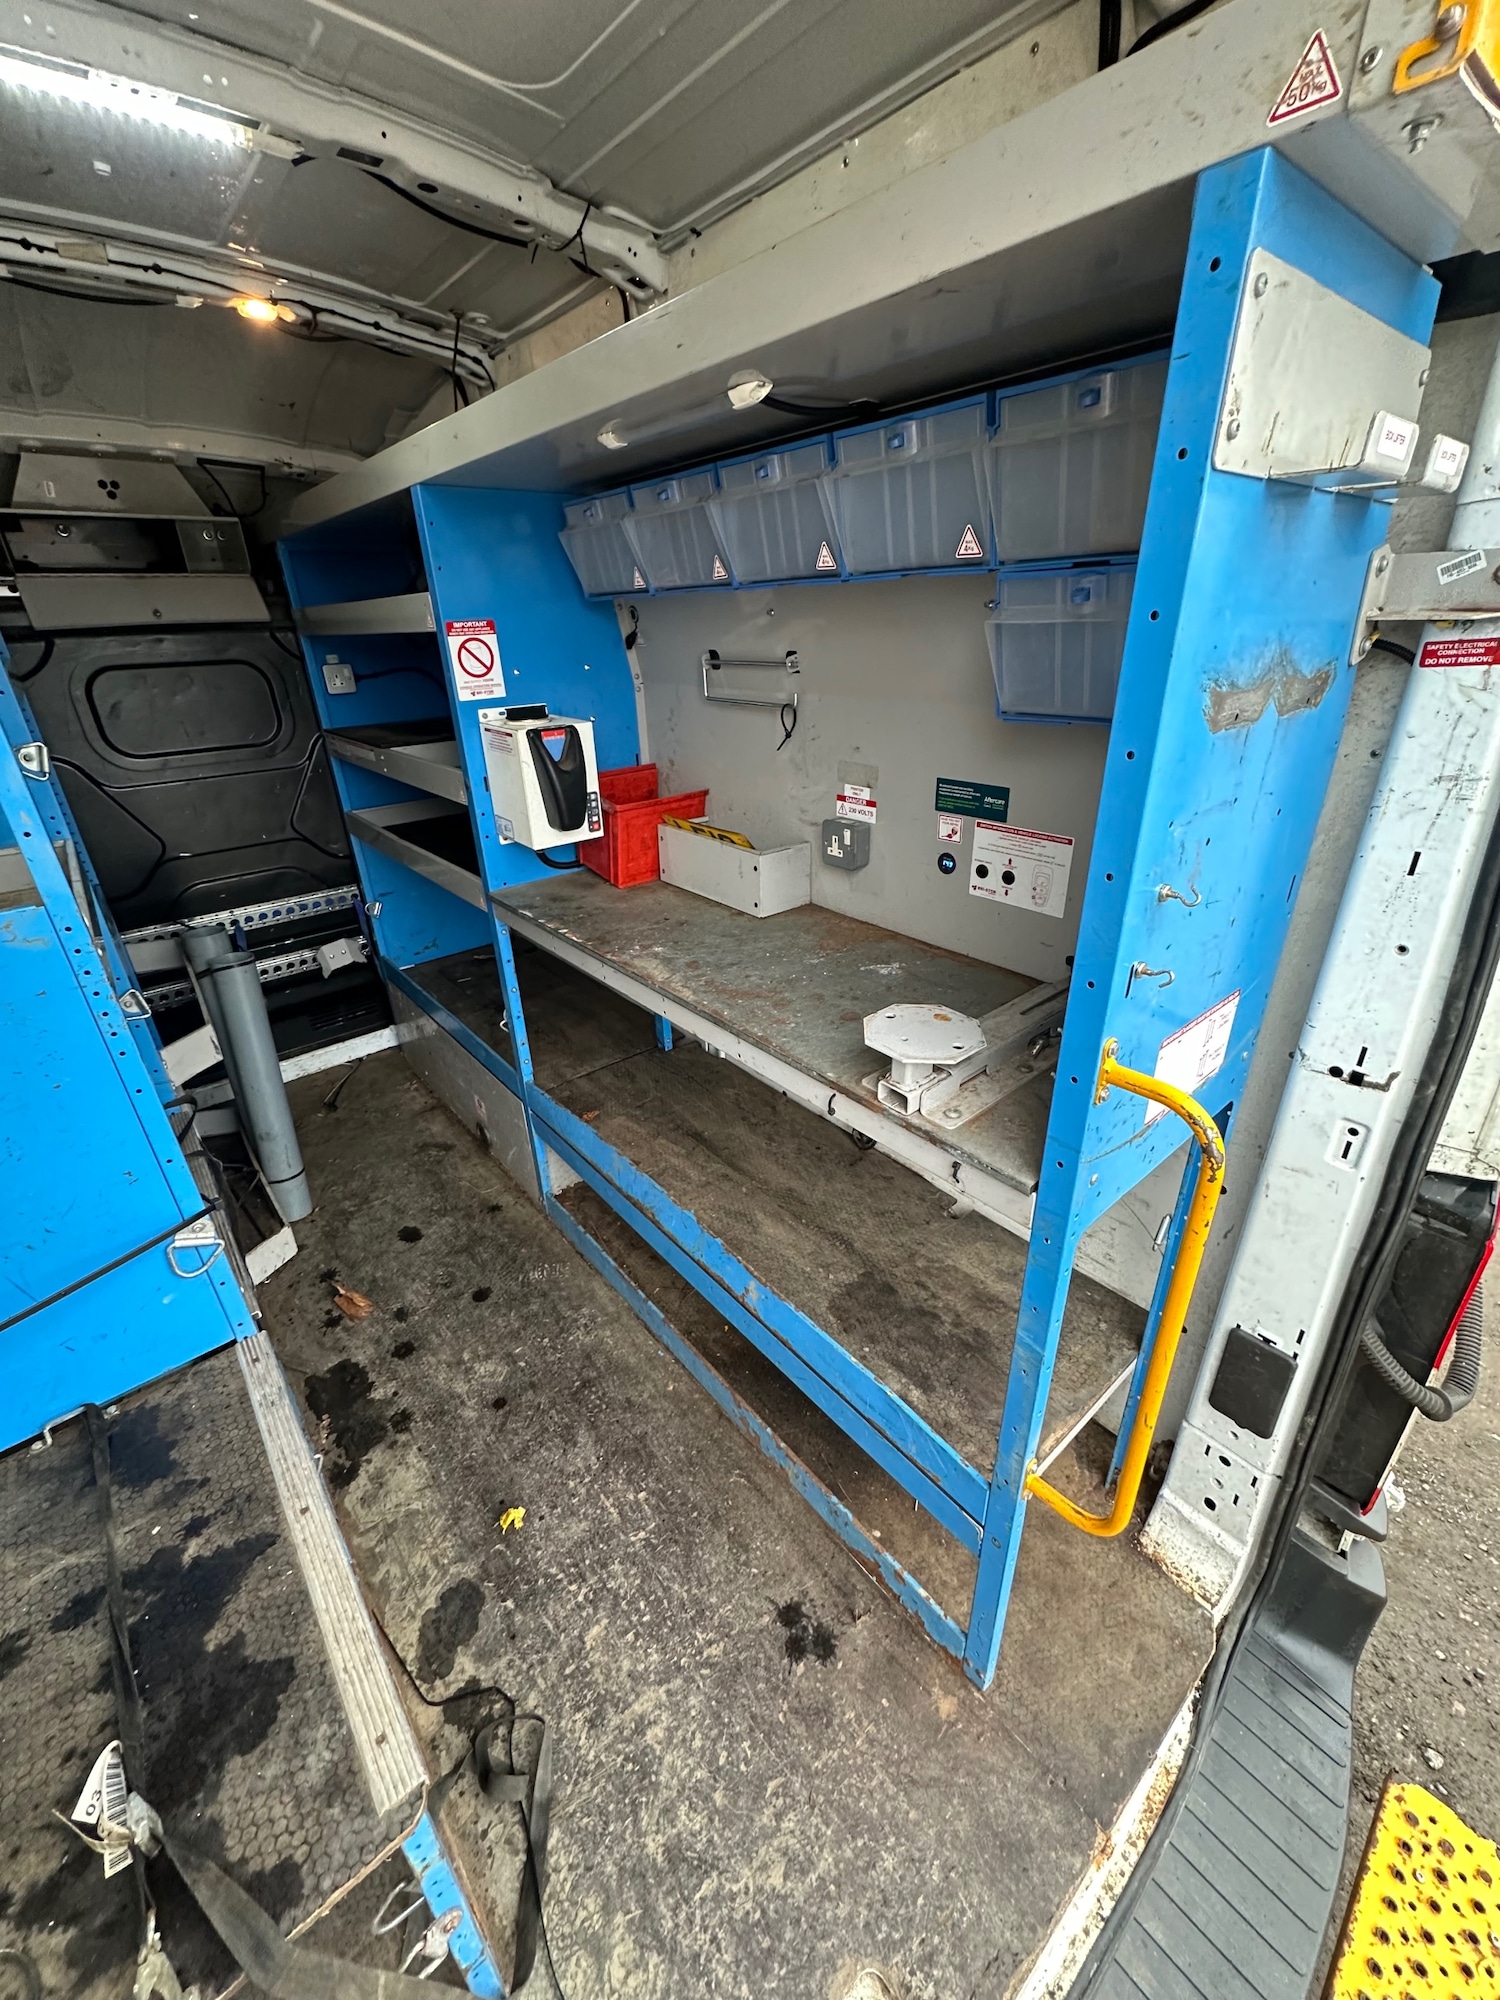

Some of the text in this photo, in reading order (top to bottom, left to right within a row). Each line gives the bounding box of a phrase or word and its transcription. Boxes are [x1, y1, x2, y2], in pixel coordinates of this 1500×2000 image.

[1437, 648, 1486, 656] CONNECTION
[1424, 655, 1495, 665] DO NOT REMOVE
[845, 796, 867, 806] DANGER
[984, 796, 1006, 805] Aftercare
[858, 809, 874, 817] VOLTS
